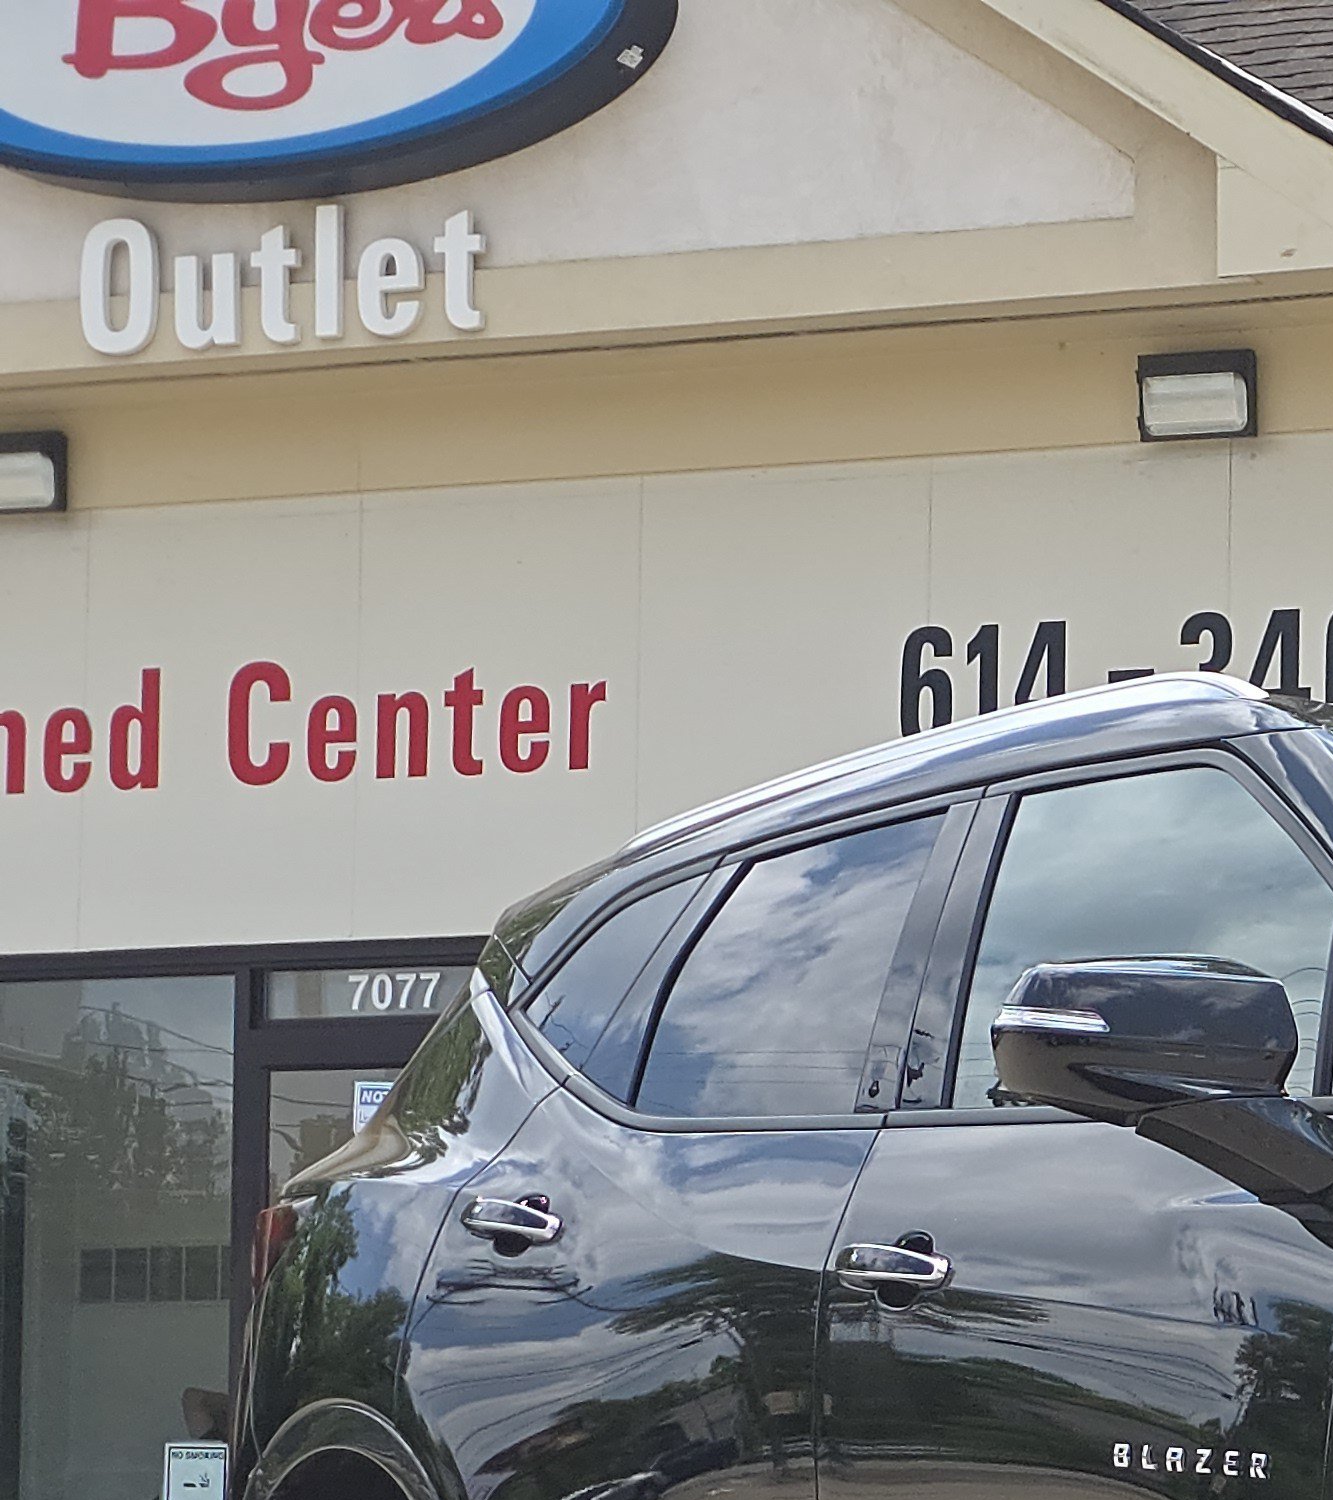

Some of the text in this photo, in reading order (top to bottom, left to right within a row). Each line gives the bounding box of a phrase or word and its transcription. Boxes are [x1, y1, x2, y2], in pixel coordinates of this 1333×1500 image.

[79, 205, 487, 356] Outlet
[227, 661, 607, 787] Center
[348, 972, 441, 1011] 7077
[1112, 1442, 1272, 1480] BLAZER
